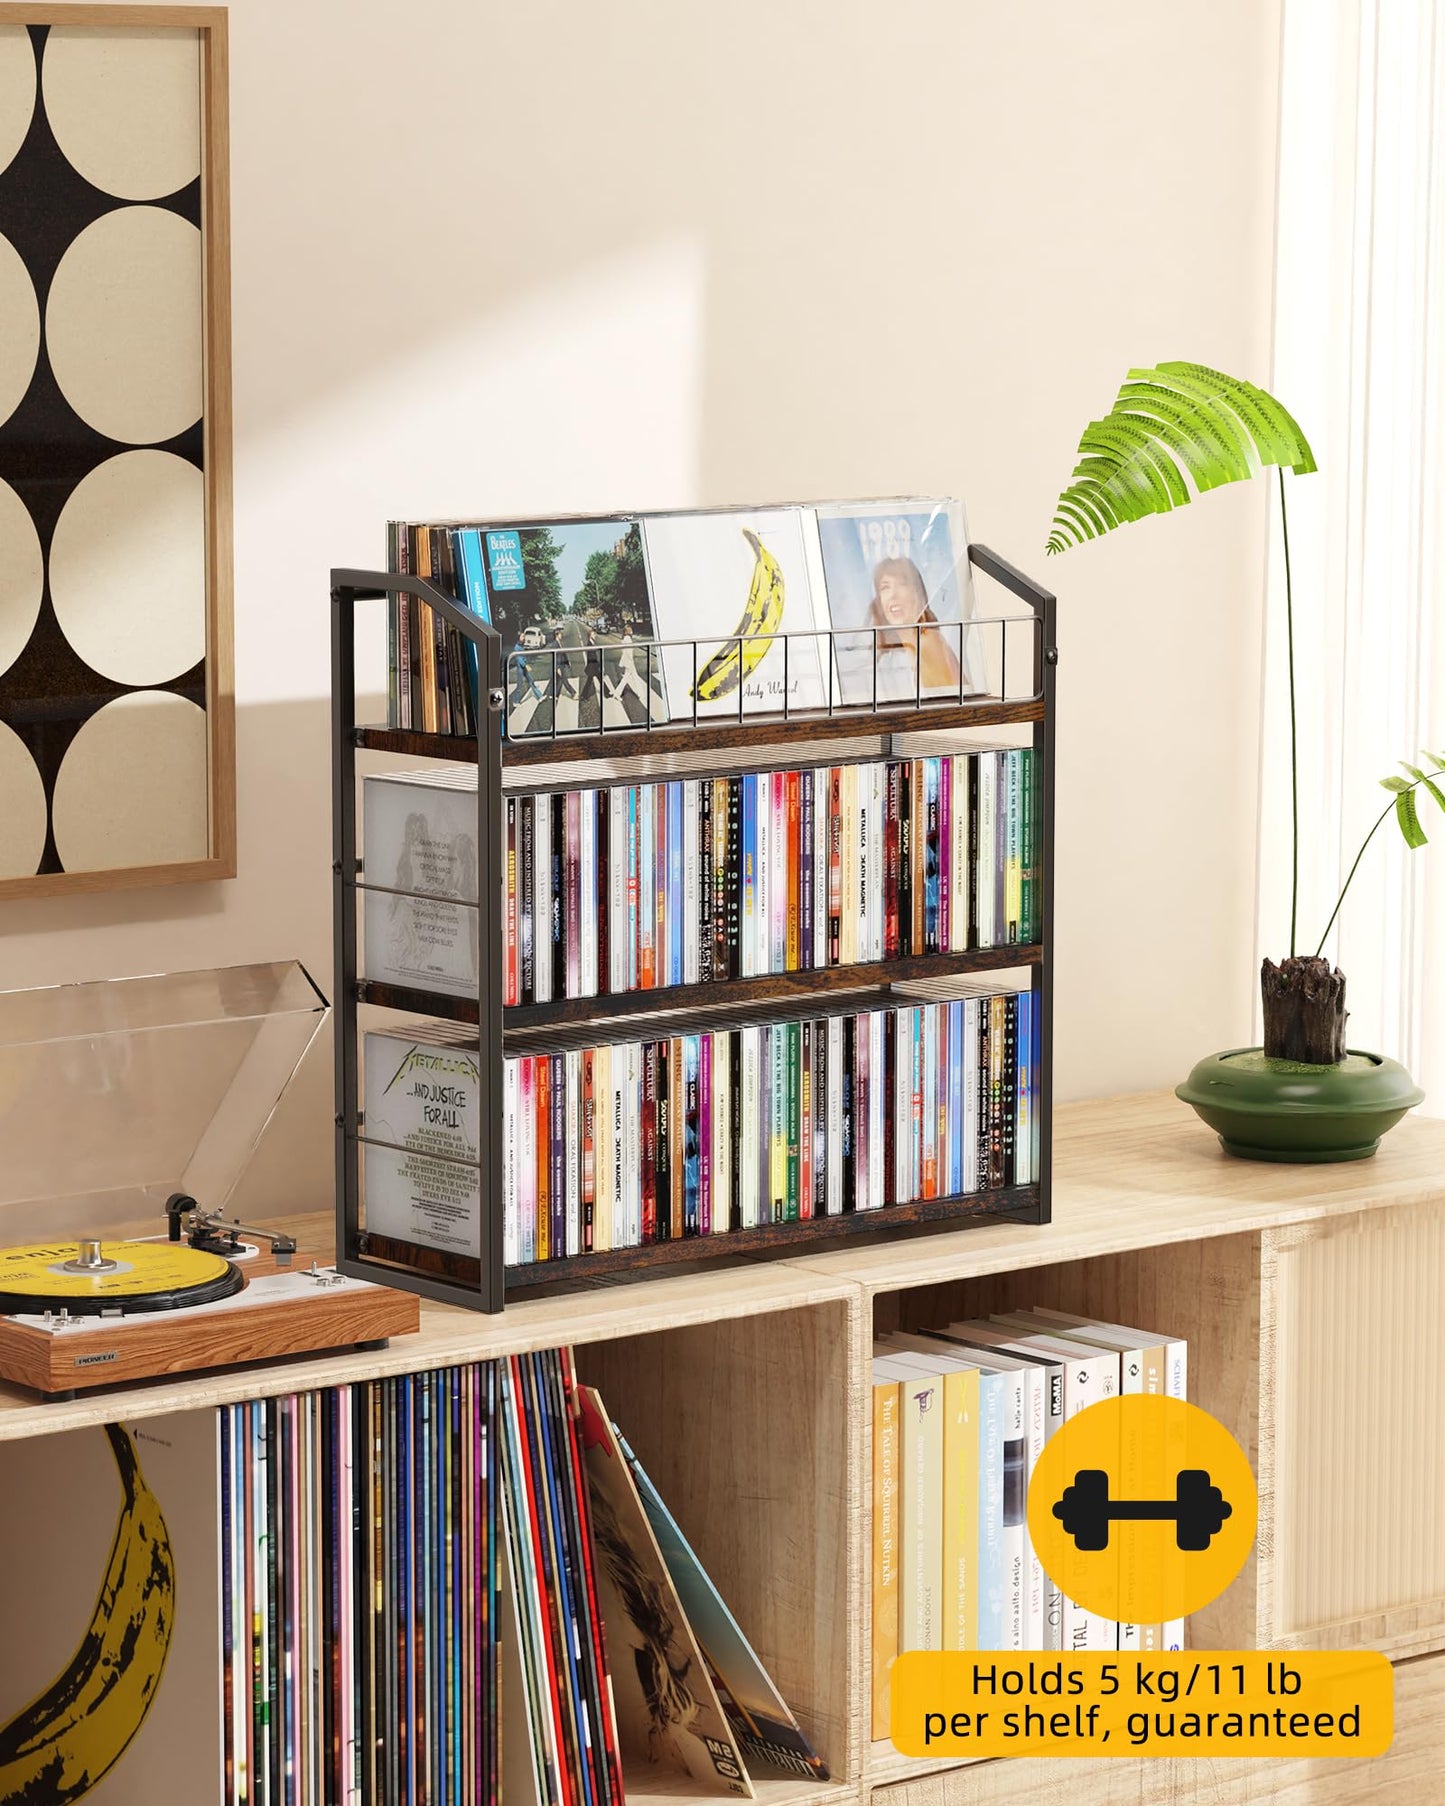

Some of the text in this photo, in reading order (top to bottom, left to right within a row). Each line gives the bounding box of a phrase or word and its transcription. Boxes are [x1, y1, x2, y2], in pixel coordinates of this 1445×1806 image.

[474, 582, 484, 613] EDITION
[742, 684, 764, 699] Andy
[430, 1084, 466, 1108] JUSTICE
[424, 1106, 459, 1128] FOR ALL
[78, 1354, 115, 1365] PIONEER
[1052, 1377, 1061, 1415] MoMA
[882, 1397, 894, 1586] THE TALE OF SQUIRREL NUTKIN
[958, 1557, 966, 1589] SANDS
[1013, 1557, 1022, 1586] design
